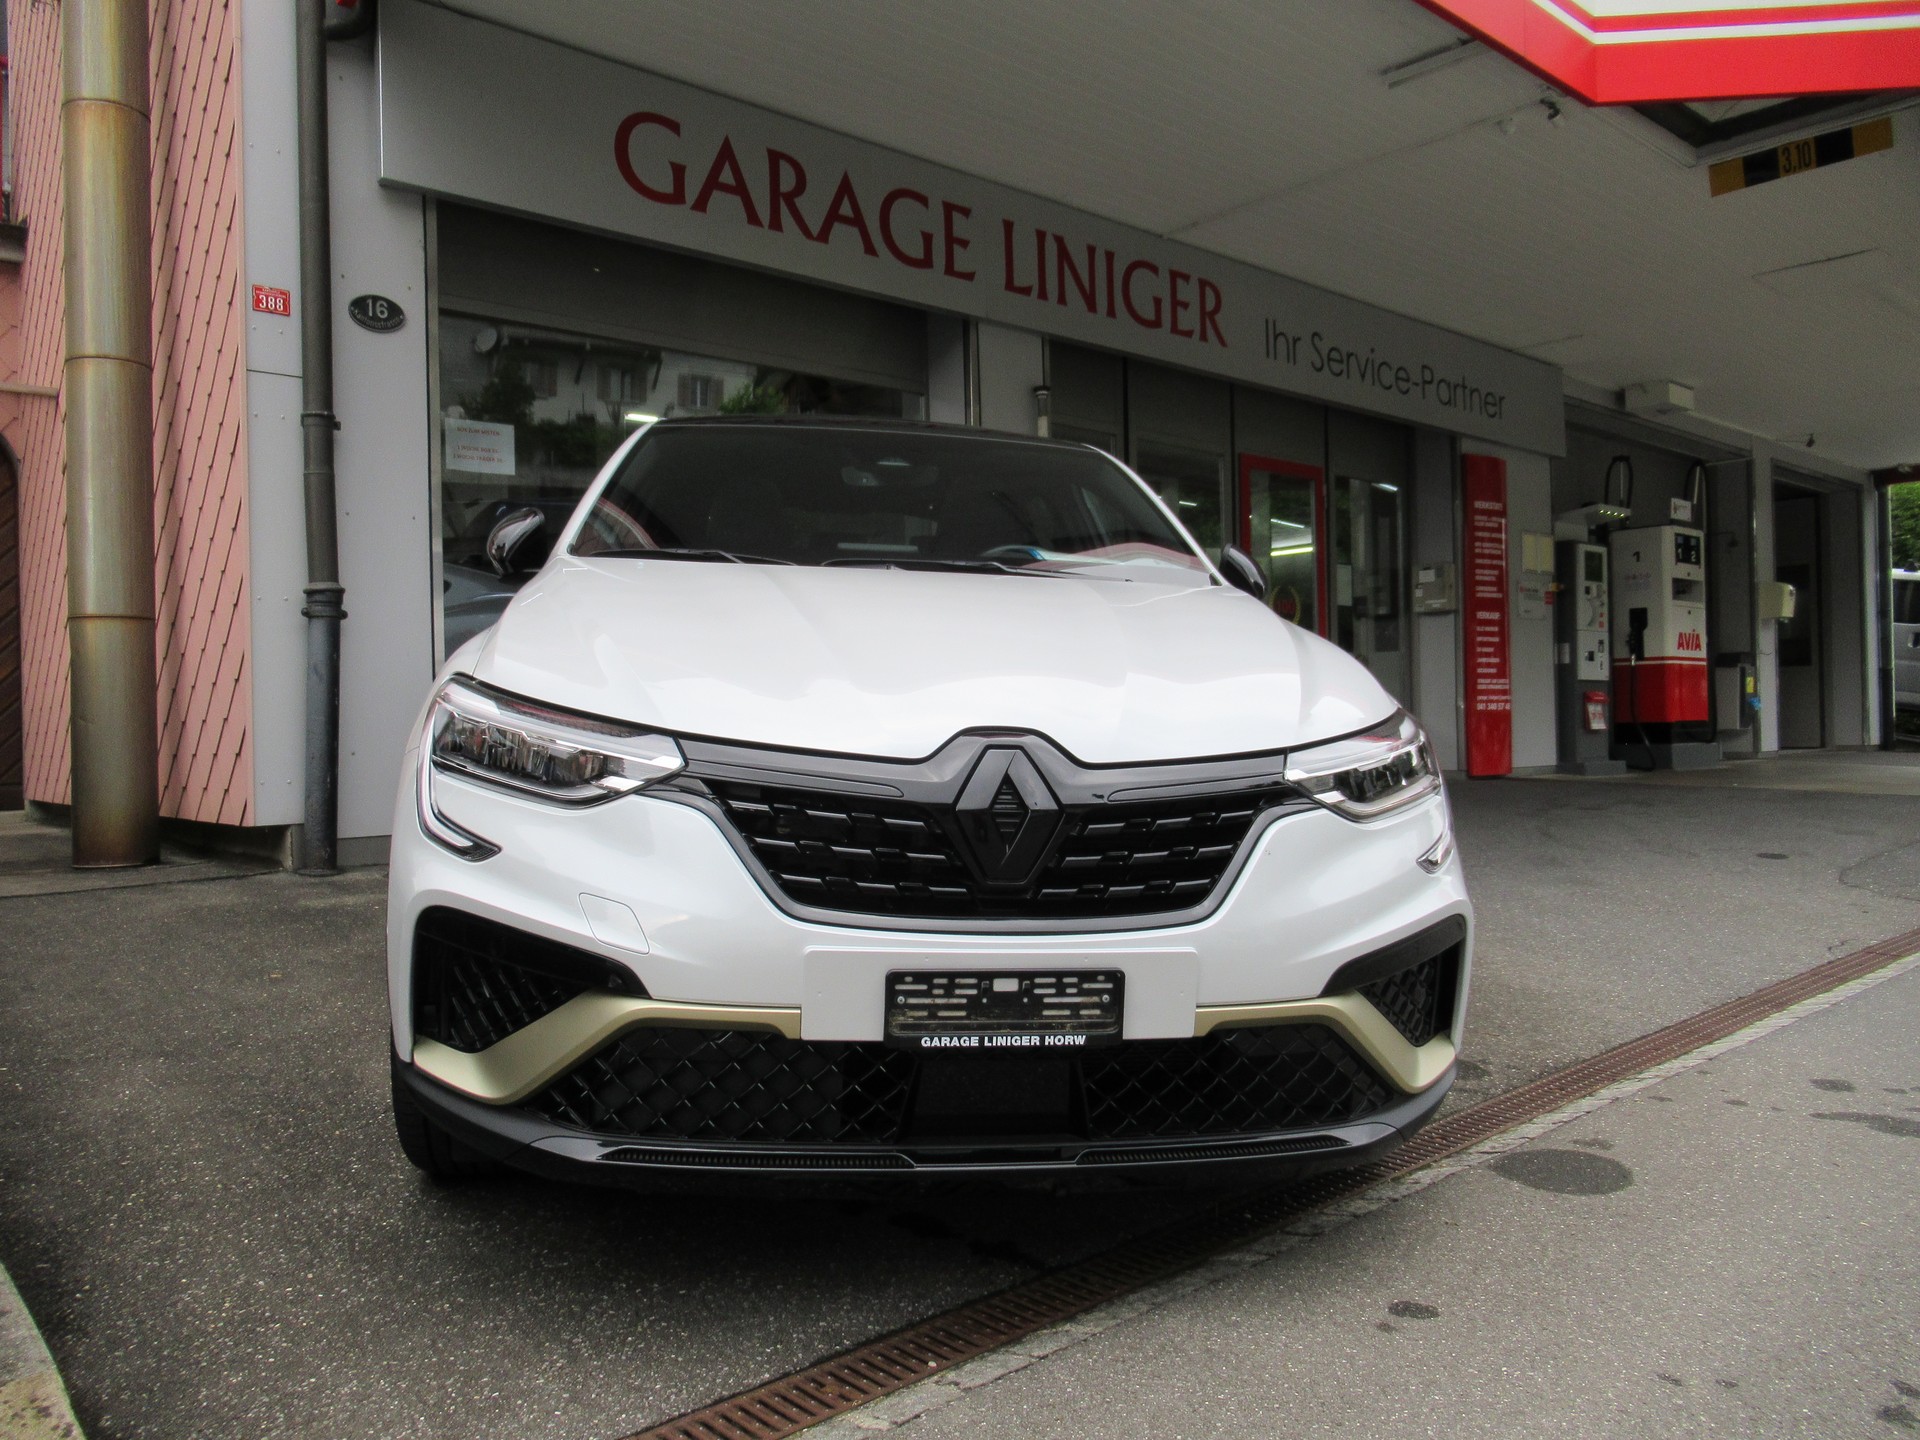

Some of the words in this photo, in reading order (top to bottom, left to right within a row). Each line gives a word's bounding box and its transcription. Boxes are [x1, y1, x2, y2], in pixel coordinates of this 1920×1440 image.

[1782, 141, 1812, 173] 3.10
[614, 111, 976, 282] GARAGE
[1002, 219, 1229, 348] LINIGER
[259, 295, 284, 311] 388
[366, 298, 389, 319] 16
[1265, 318, 1301, 366] Ihr
[1311, 331, 1506, 420] Service-Partner
[1632, 551, 1641, 562] 1
[1677, 547, 1683, 559] 1
[1690, 550, 1697, 562] 2
[1677, 629, 1702, 651] AVIA
[921, 1036, 979, 1047] GARAGE
[984, 1035, 1040, 1046] LINIGER
[1044, 1034, 1087, 1046] HORW
